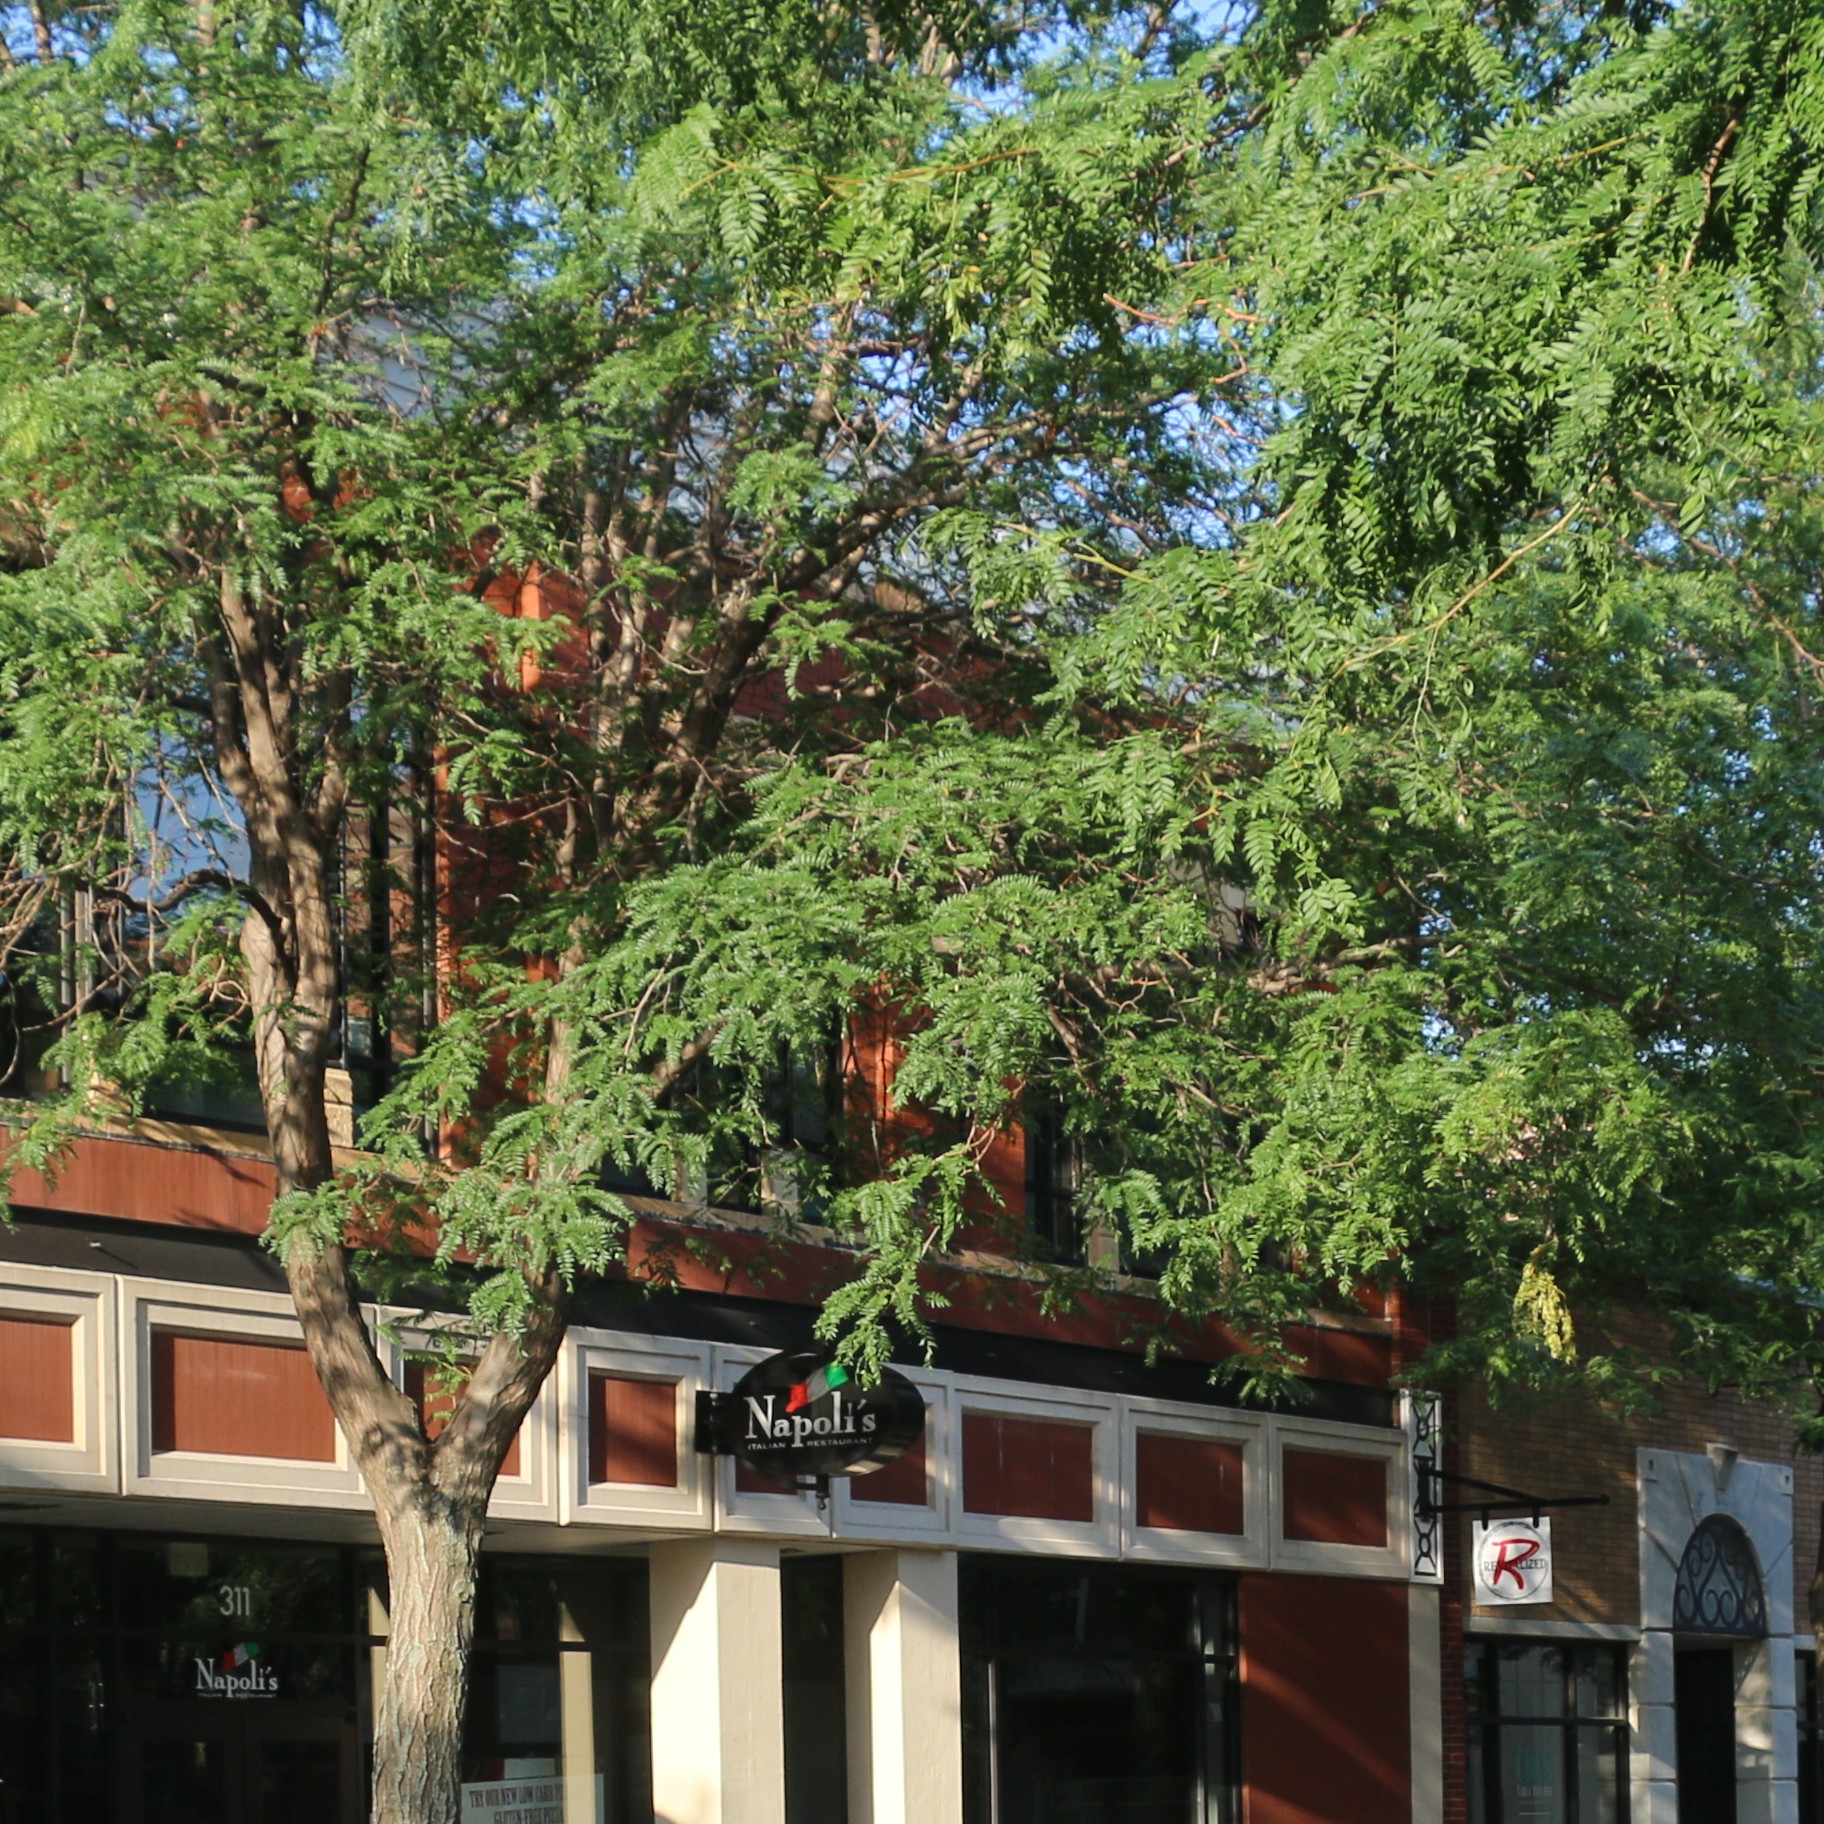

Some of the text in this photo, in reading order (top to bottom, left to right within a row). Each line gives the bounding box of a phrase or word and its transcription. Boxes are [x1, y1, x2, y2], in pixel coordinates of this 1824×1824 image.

[743, 1390, 877, 1448] Napoli's
[747, 1437, 874, 1450] ITALIAN RESTAURANT
[219, 1585, 250, 1616] 311
[193, 1657, 279, 1698] Napoli's
